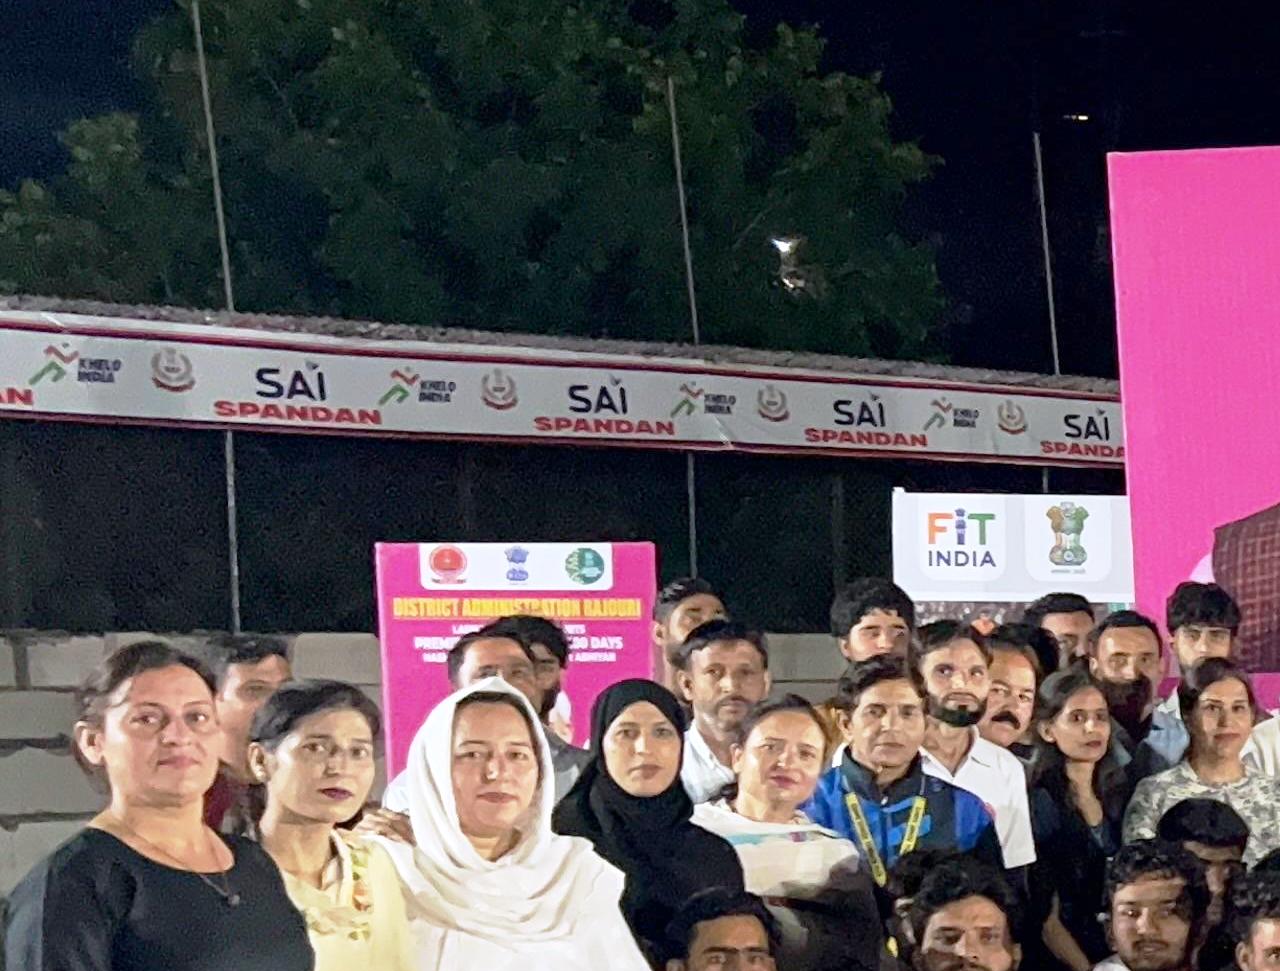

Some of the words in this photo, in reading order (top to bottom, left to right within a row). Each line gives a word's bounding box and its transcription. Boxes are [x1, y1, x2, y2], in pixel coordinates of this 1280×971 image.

[255, 367, 327, 401] SAI
[213, 399, 383, 426] SPANDAN
[568, 384, 628, 415] SAI
[534, 416, 675, 436] SPANDAN
[833, 399, 886, 428] SAI
[804, 428, 928, 447] SPANDAN
[1063, 414, 1110, 441] SAI
[927, 550, 997, 567] INDIA
